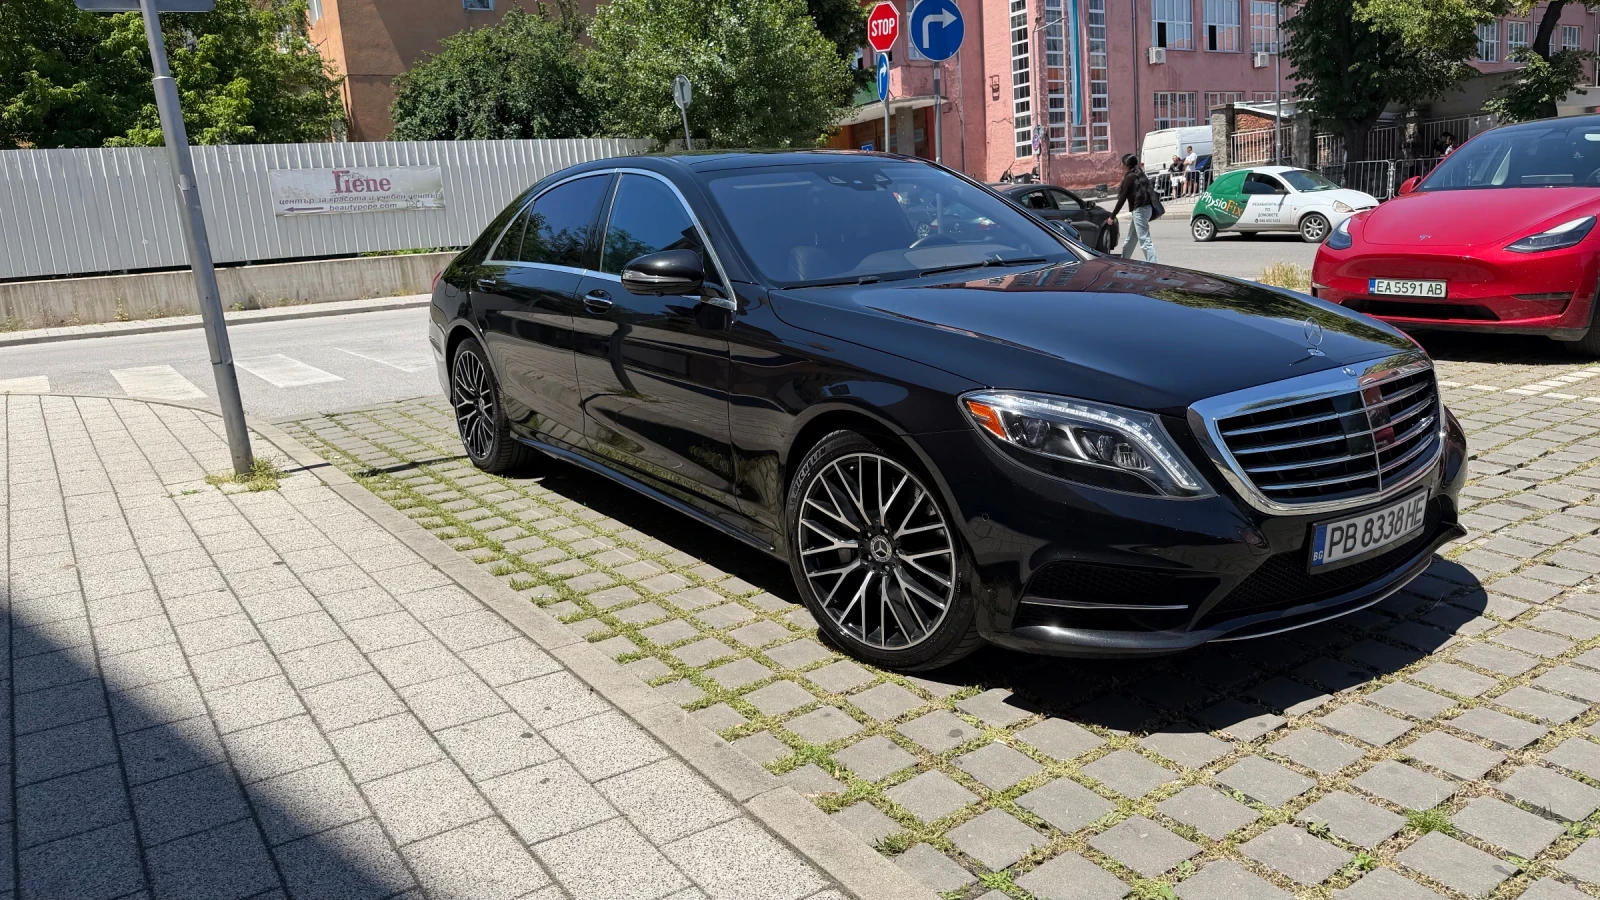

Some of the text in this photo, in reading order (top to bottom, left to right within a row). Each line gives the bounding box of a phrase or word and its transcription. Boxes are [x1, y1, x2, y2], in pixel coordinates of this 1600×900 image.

[871, 17, 895, 37] STOP
[279, 198, 315, 206] център
[329, 194, 367, 204] красота
[376, 193, 406, 201] учебен
[408, 193, 441, 201] център
[329, 203, 398, 212] beautypepe.com
[1201, 191, 1243, 217] PhysioFix
[1376, 281, 1391, 293] EA
[1394, 282, 1423, 294] 5591
[1427, 283, 1442, 295] AB
[793, 446, 826, 495] MICHELIN
[1328, 495, 1425, 557] PB 8338 HE
[1313, 550, 1324, 560] BG
